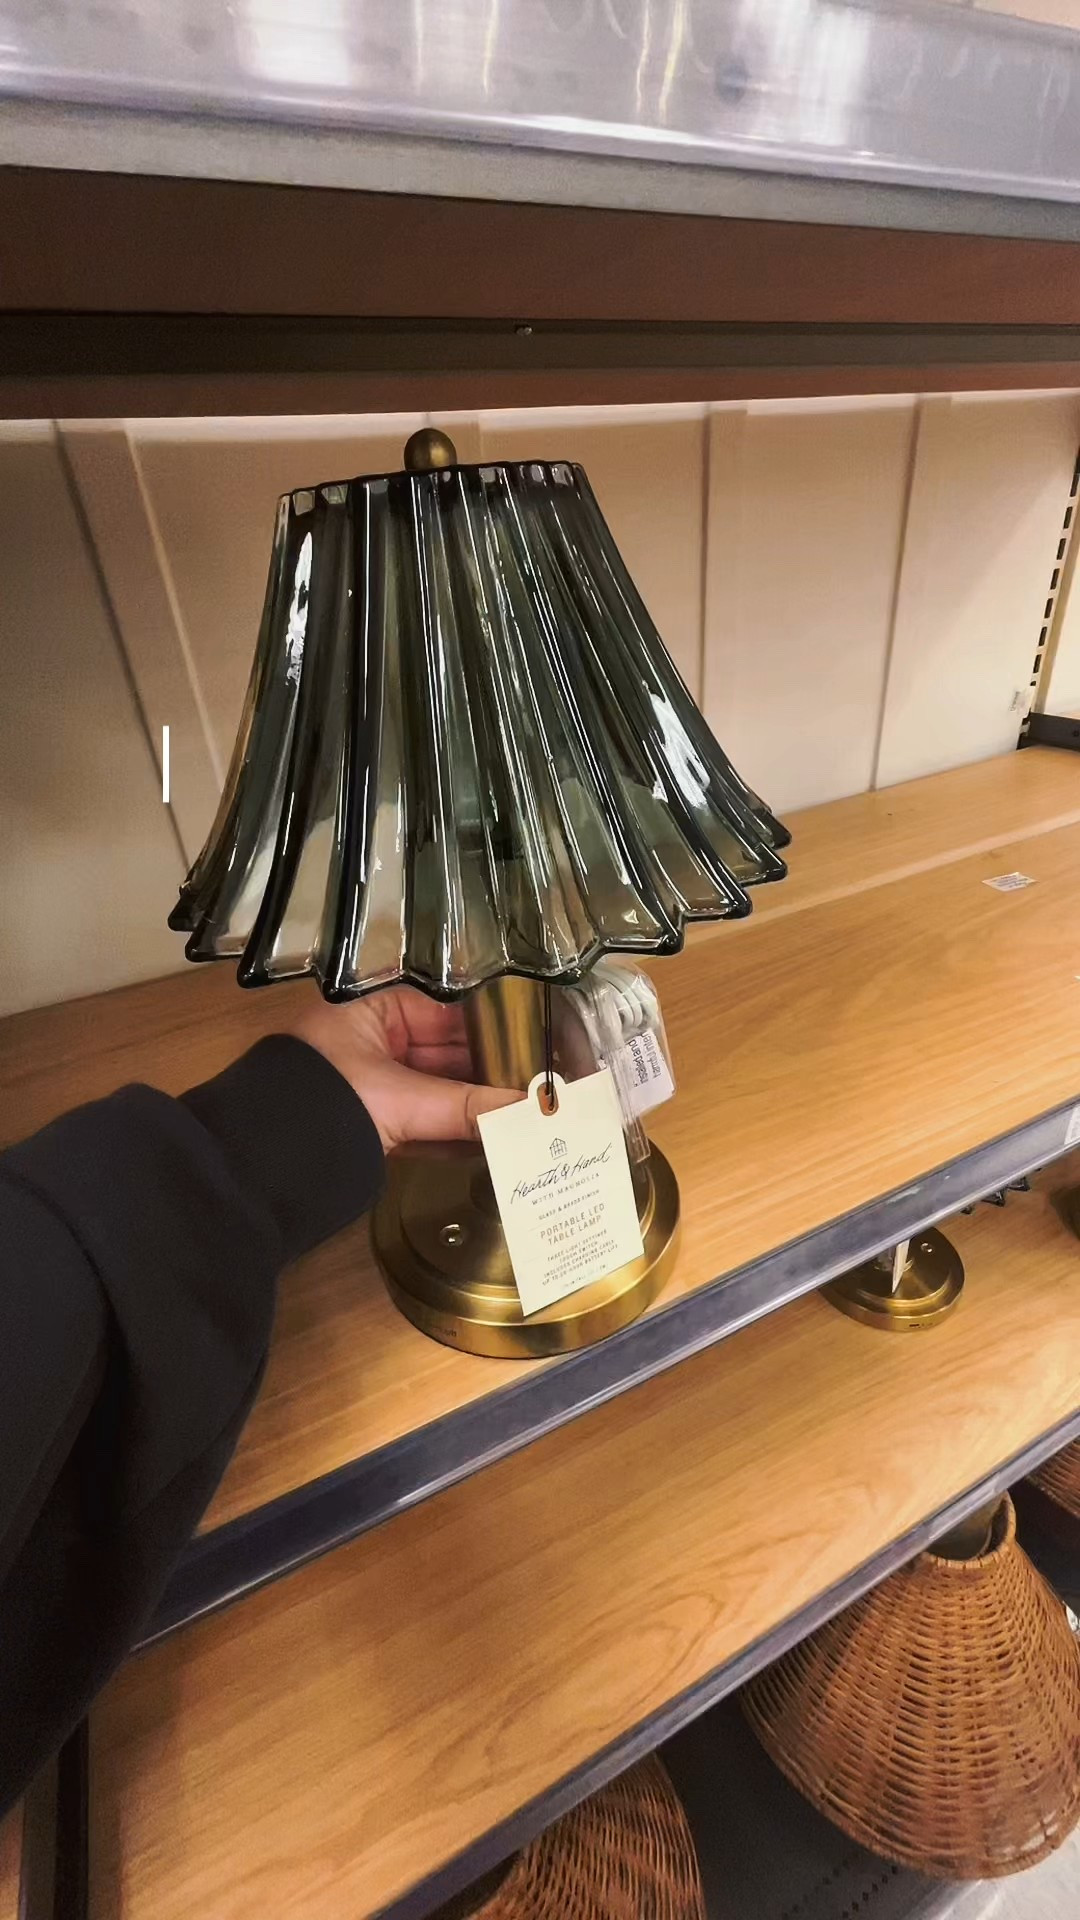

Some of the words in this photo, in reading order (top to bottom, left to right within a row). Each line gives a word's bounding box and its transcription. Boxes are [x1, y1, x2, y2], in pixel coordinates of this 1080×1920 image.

[625, 1039, 641, 1056] and
[510, 1163, 561, 1204] Hearth
[561, 1164, 570, 1180] &
[571, 1143, 612, 1180] Hand
[540, 1208, 586, 1239] PORTABLE
[588, 1202, 605, 1216] LED
[548, 1226, 575, 1245] TABLE
[579, 1214, 602, 1231] LAMP
